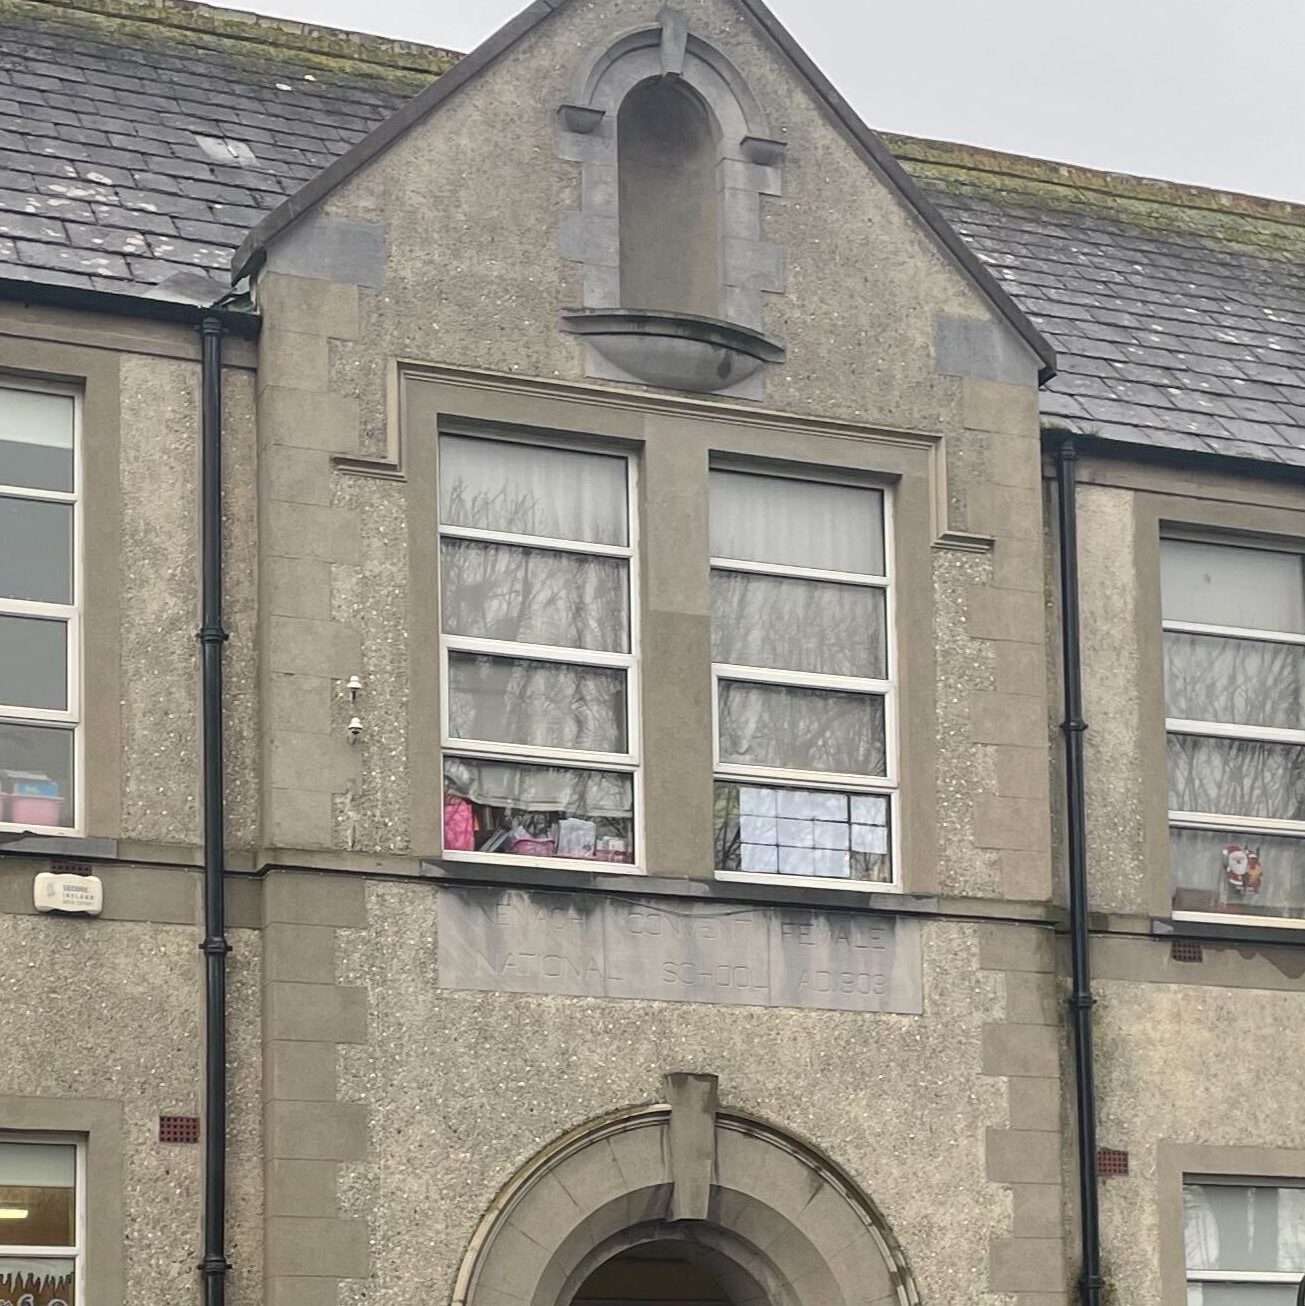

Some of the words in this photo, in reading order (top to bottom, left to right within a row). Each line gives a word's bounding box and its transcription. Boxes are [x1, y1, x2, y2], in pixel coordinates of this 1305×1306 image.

[627, 912, 753, 945] CONVENT
[780, 921, 887, 950] FEMALE
[475, 949, 623, 981] NATIONAL
[662, 961, 769, 990] SCHOOL
